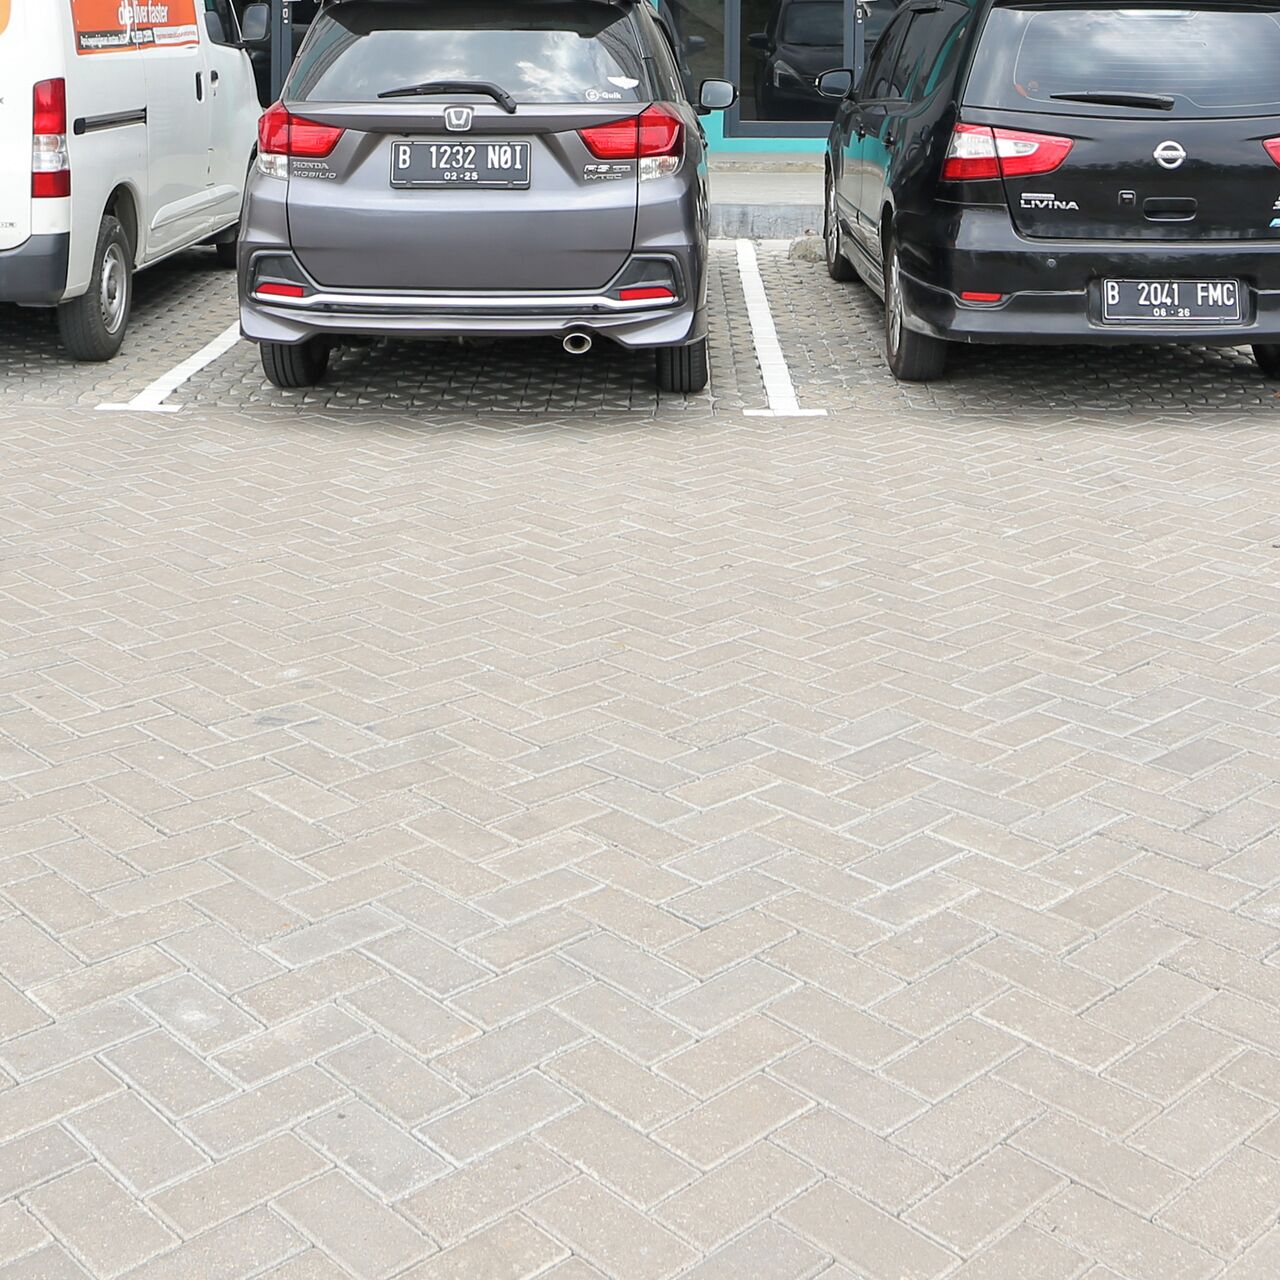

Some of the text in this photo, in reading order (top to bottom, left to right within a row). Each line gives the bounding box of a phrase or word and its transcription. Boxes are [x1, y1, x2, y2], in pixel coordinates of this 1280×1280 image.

[149, 0, 169, 23] faster
[292, 161, 329, 169] HONDA
[398, 145, 410, 168] B
[429, 145, 476, 169] 1232
[293, 171, 337, 179] MOBILIO
[1020, 200, 1079, 210] LIVINA
[1107, 282, 1234, 306] B 2041 FMC
